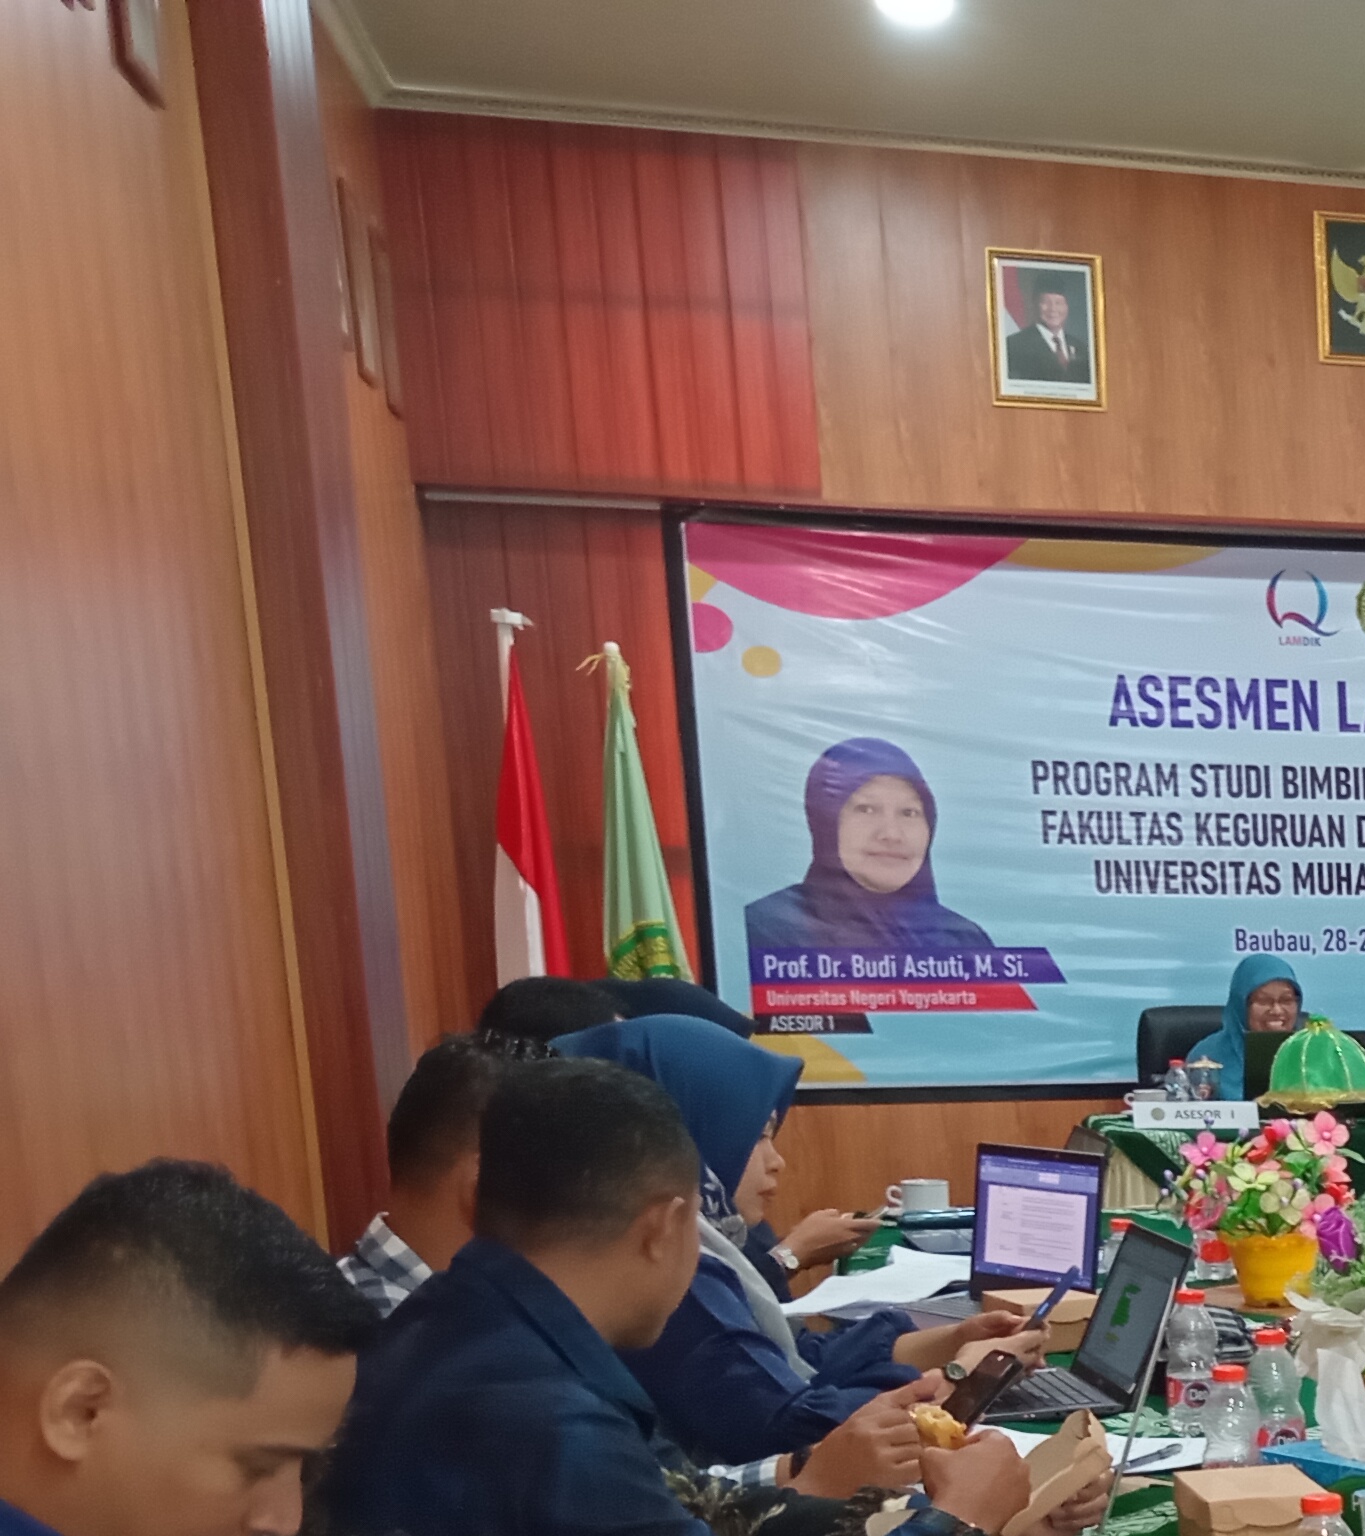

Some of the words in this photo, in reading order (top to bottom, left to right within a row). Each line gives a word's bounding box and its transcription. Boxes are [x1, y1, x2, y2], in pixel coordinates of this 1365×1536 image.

[1278, 635, 1321, 647] LAMDIK
[1109, 674, 1320, 732] ASESMEN
[1030, 760, 1180, 798] PROGRAM
[1190, 763, 1272, 799] STUDI
[1041, 810, 1184, 846] FAKULTAS
[1194, 812, 1346, 848] KEGURUAN
[1094, 859, 1282, 896] UNIVERSITAS
[1234, 928, 1317, 955] Baubau,
[763, 954, 813, 979] Prof.
[817, 954, 847, 979] Dr.
[852, 954, 897, 979] Budi
[903, 954, 971, 981] Astuti,
[975, 955, 999, 978] M.
[1003, 954, 1030, 978] Si.
[765, 989, 848, 1007] Universitas
[850, 988, 896, 1010] Negeri
[899, 988, 977, 1009] Yogyakarta
[769, 1014, 825, 1033] ASESOR
[827, 1014, 836, 1031] 1
[1174, 1109, 1222, 1120] ASESOR
